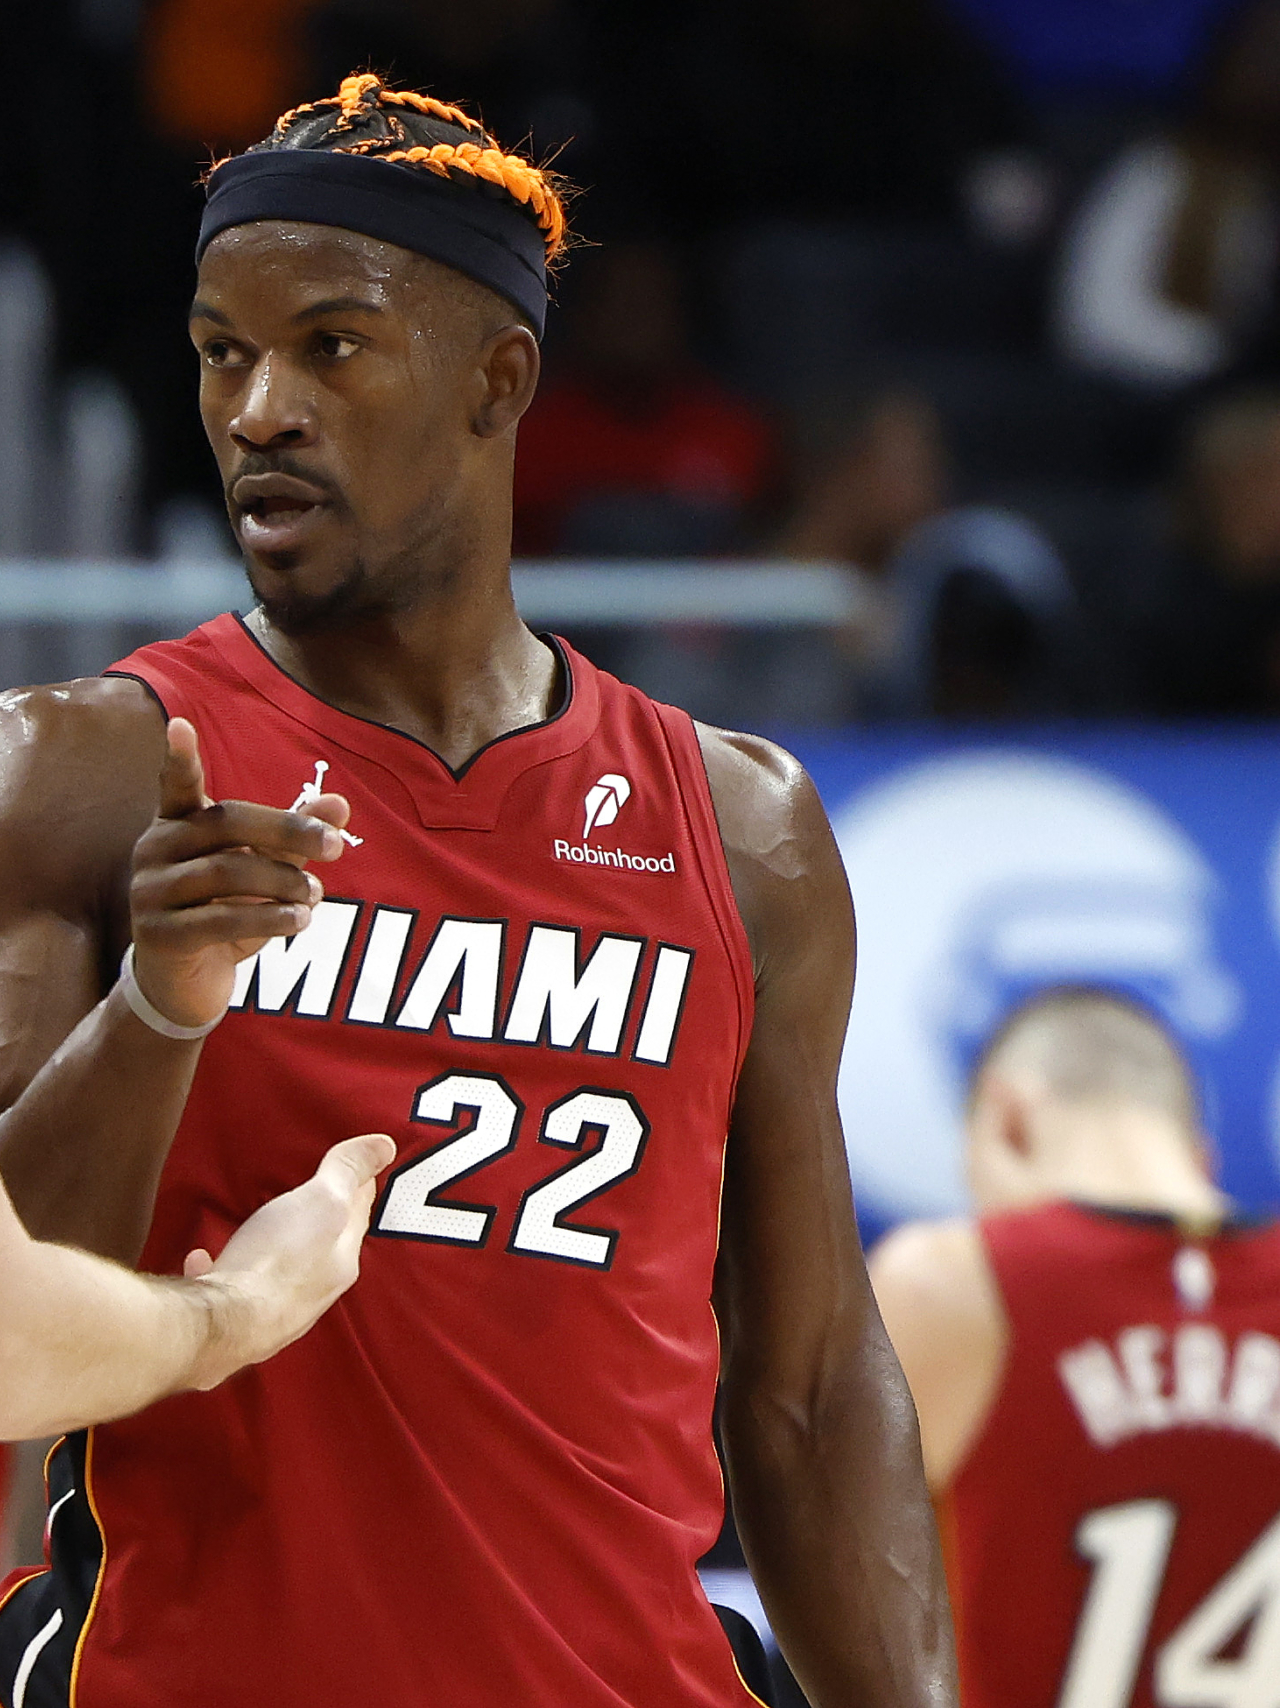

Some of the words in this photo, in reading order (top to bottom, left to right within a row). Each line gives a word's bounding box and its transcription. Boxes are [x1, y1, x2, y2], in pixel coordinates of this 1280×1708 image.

[554, 839, 676, 873] Robinhood
[228, 897, 695, 1068] MIAMI
[373, 1068, 651, 1271] 22
[1056, 1499, 1280, 1708] 14
